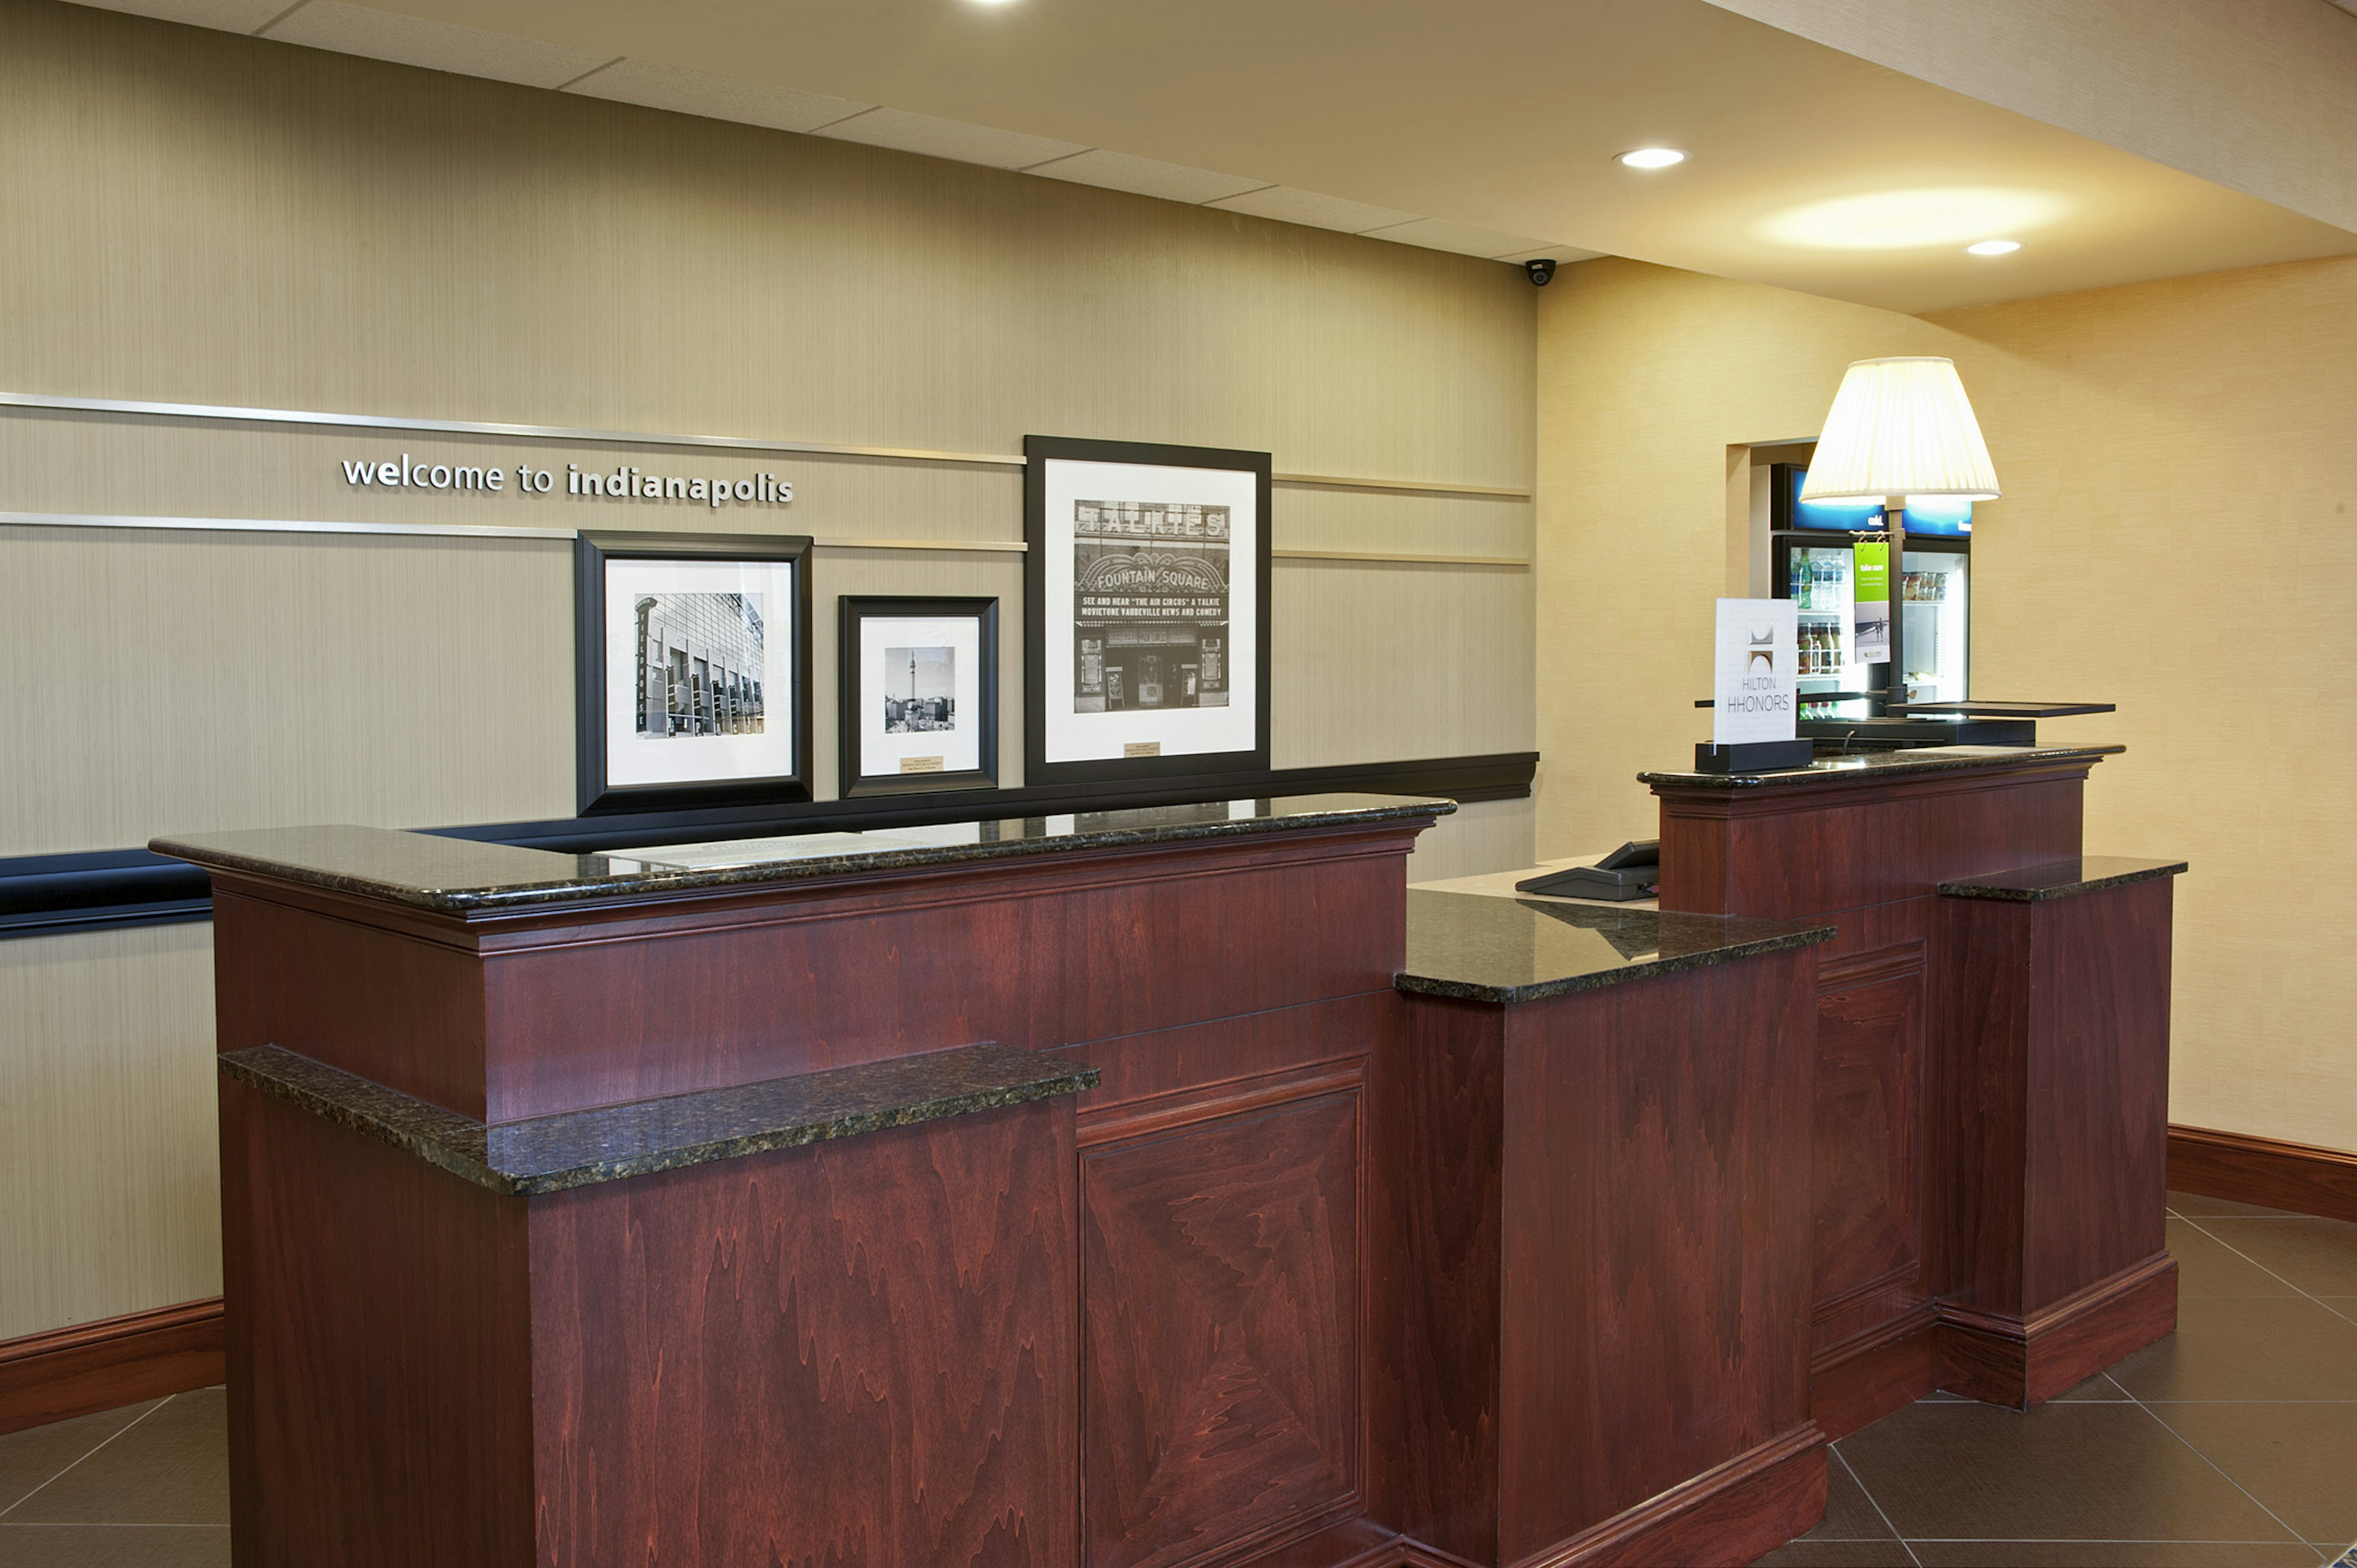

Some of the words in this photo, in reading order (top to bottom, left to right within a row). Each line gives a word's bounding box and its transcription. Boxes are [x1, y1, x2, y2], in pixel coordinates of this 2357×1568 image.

[342, 454, 504, 491] welcome
[518, 463, 554, 493] to
[568, 463, 794, 507] indianapolis
[1097, 570, 1155, 589] FOUNTAIN
[1162, 570, 1209, 590] SQUARE
[1083, 597, 1095, 605] SEE
[1097, 597, 1111, 606] AND
[1112, 597, 1130, 606] HEAR
[1150, 597, 1161, 606] AIR
[1082, 607, 1119, 616] MOVIETONE
[1742, 677, 1777, 691] HILTON
[1728, 694, 1789, 713] HHONORS
